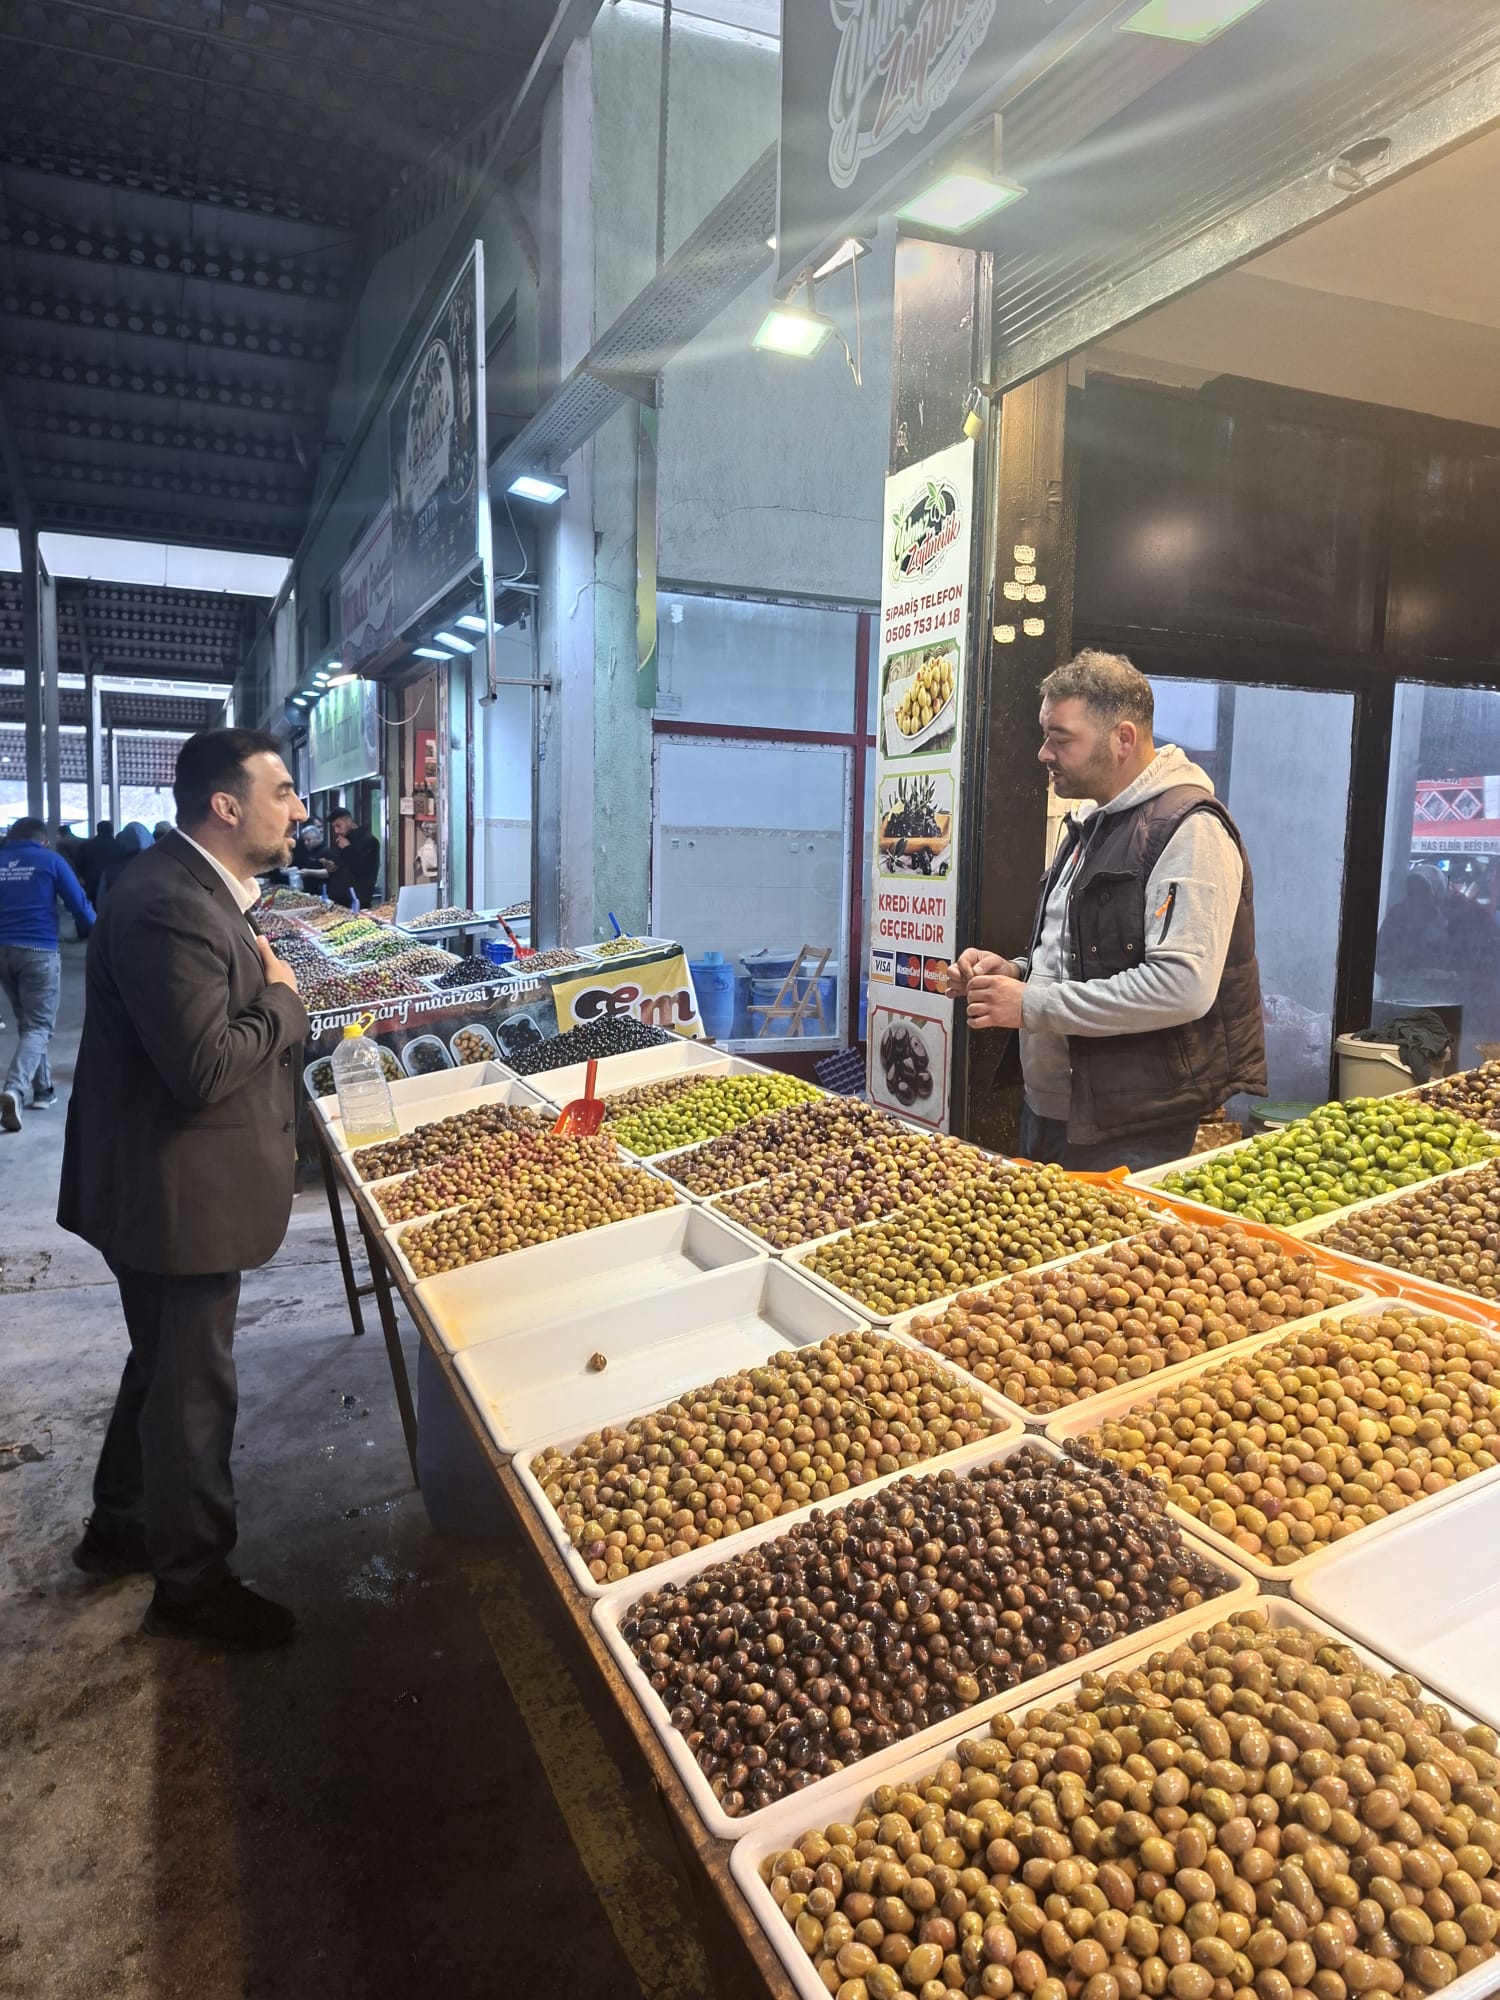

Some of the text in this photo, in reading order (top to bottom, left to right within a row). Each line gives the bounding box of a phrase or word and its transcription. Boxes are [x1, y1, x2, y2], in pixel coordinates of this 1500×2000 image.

[921, 584, 963, 613] TELEFON
[886, 607, 961, 644] 0506 753 14 18
[1421, 840, 1438, 852] HAS
[1464, 839, 1482, 852] REİS
[912, 896, 946, 917] KARTI
[875, 959, 891, 973] VISA
[311, 1014, 365, 1040] ğanın
